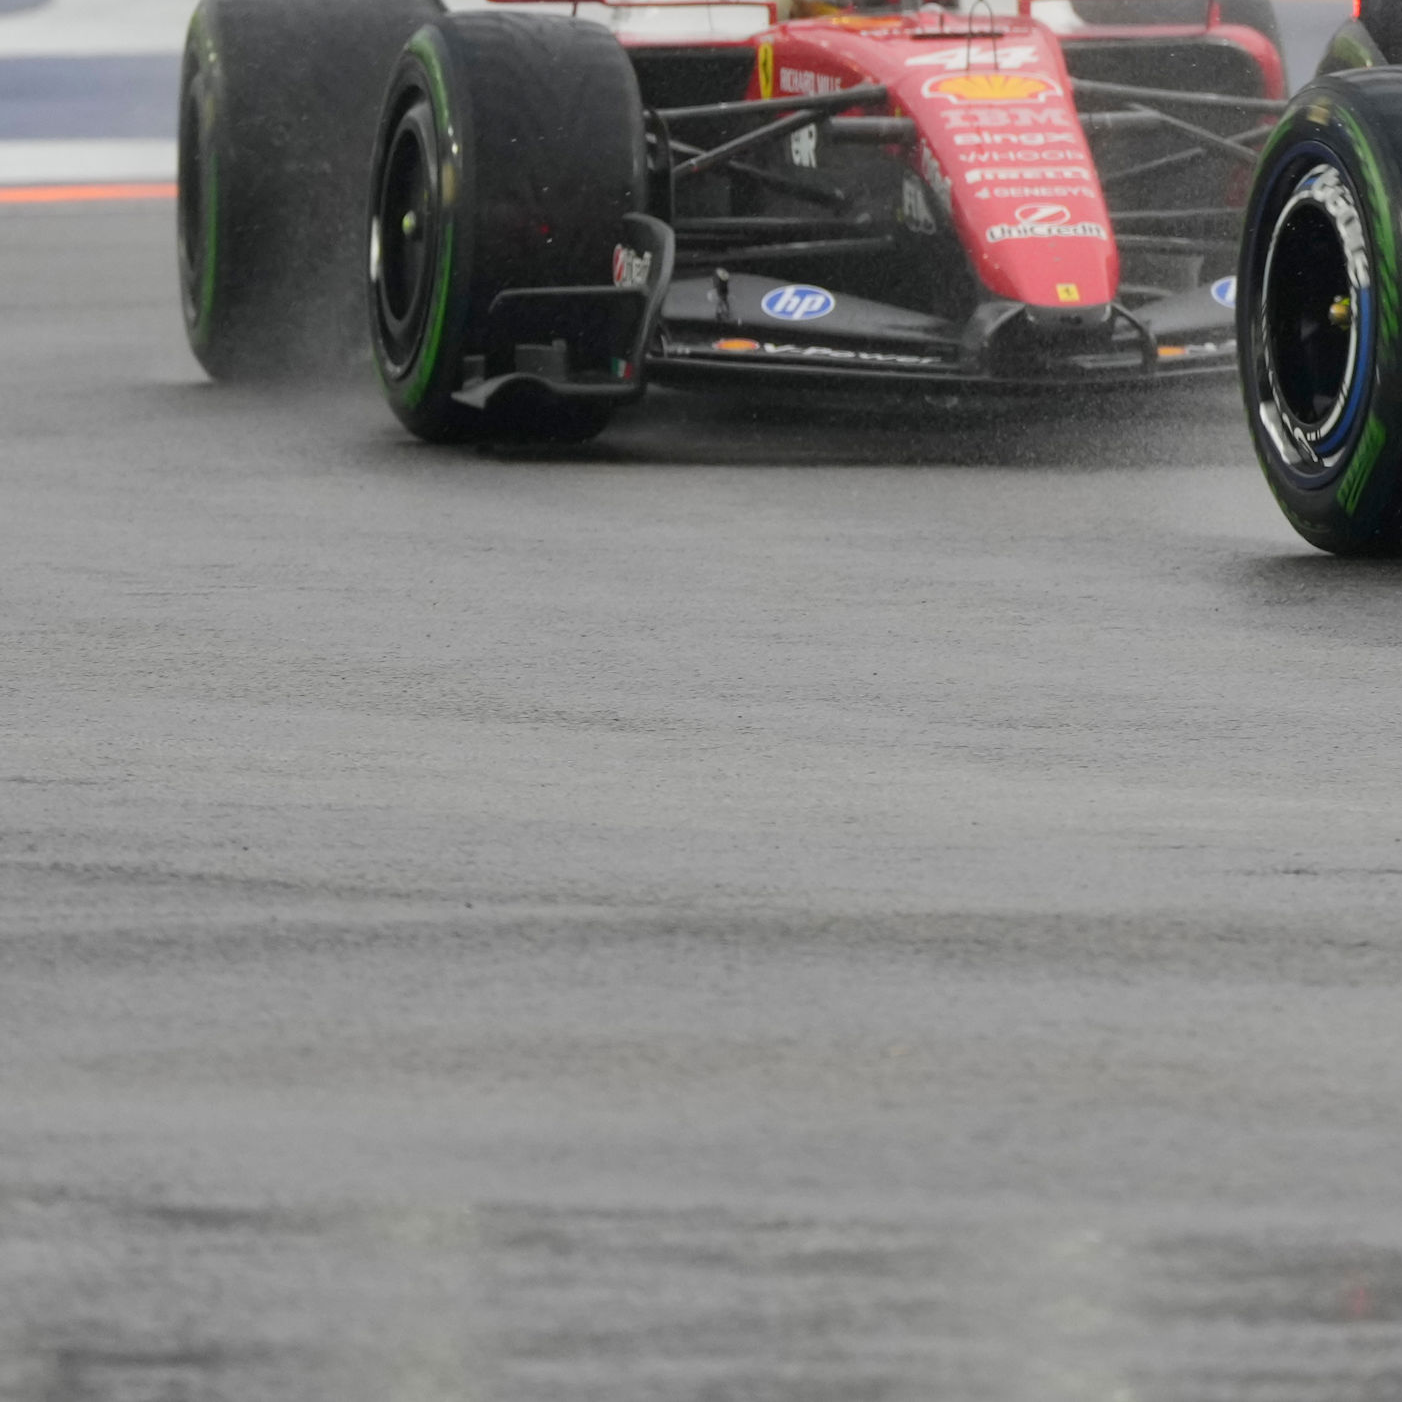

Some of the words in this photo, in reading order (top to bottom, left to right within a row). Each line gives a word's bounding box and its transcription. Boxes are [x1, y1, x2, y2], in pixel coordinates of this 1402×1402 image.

[904, 46, 1040, 70] 44
[940, 108, 1070, 129] IBM
[772, 285, 827, 320] hp
